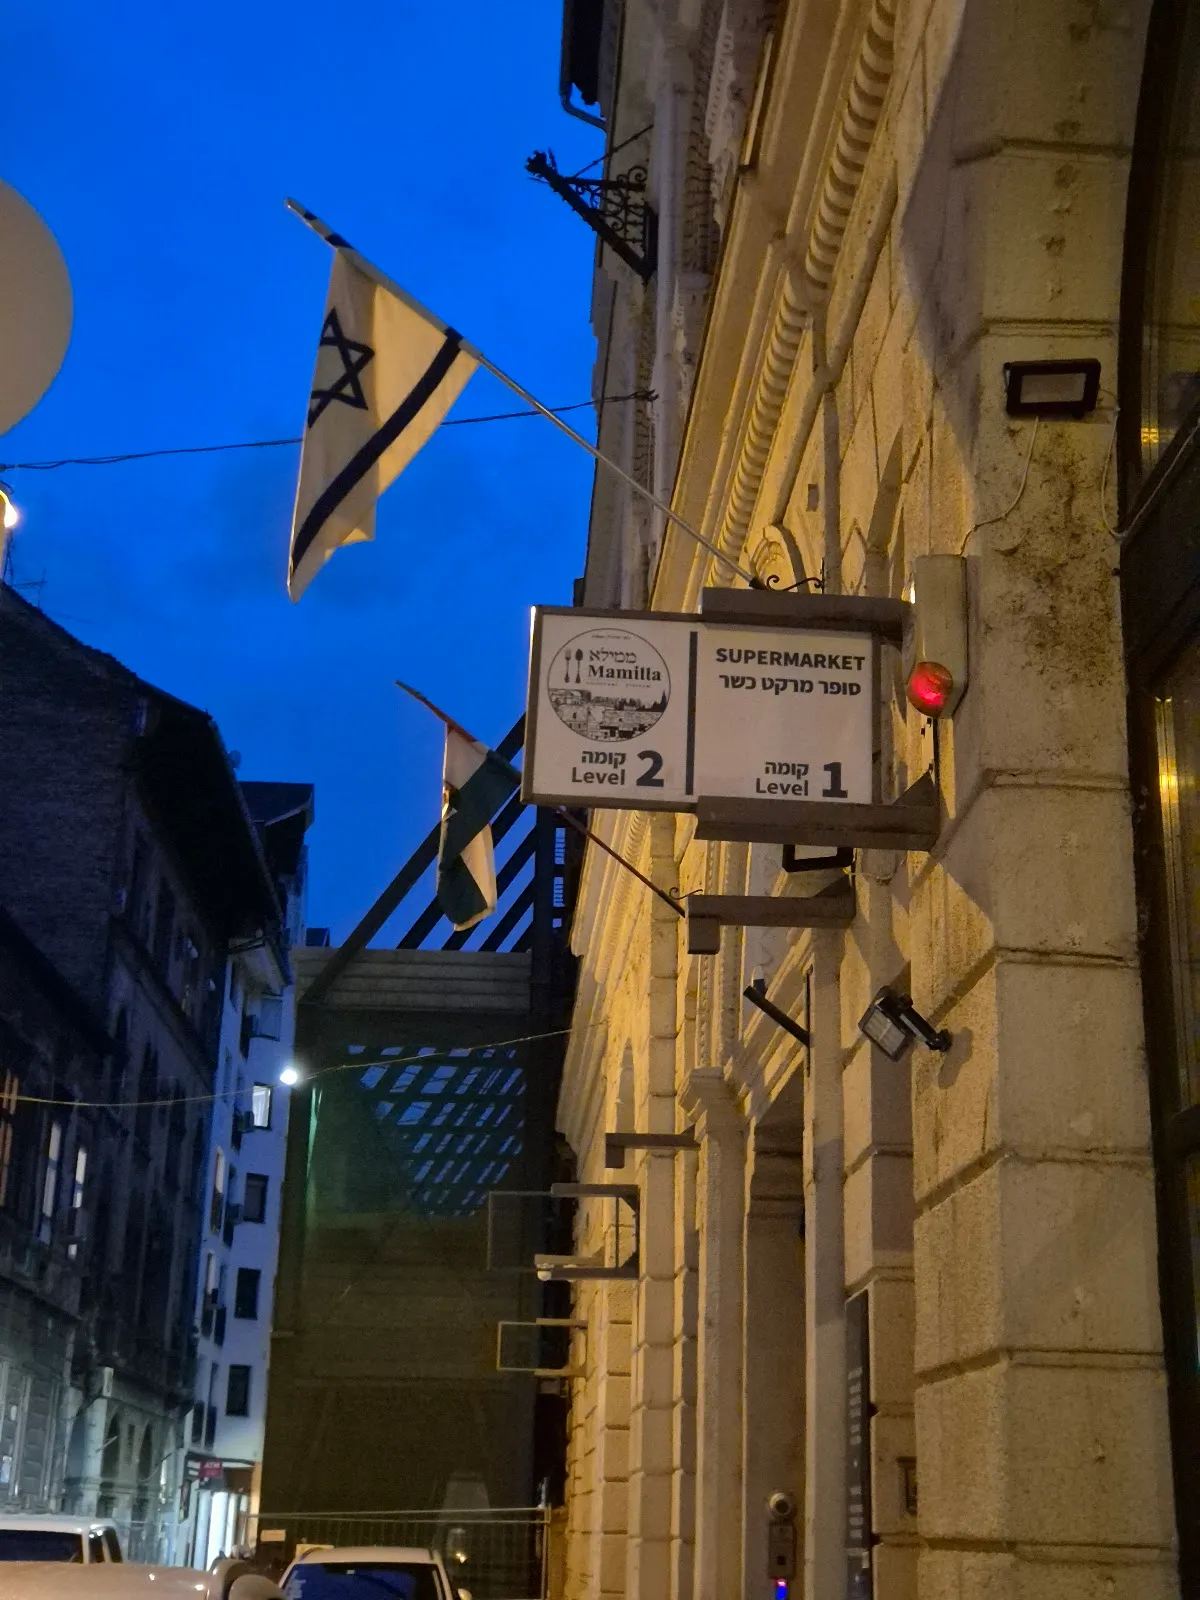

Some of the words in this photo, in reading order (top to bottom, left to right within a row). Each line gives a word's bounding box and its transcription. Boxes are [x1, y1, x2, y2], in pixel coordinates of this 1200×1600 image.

[589, 647, 637, 664] ממילא
[716, 648, 865, 670] SUPERMARKET
[588, 665, 661, 681] Mamilla
[719, 674, 756, 691] כשר
[761, 677, 813, 695] מרקט
[818, 681, 861, 696] סופר
[581, 750, 626, 768] קומה
[571, 767, 625, 786] Level
[636, 750, 664, 787] 2
[764, 761, 809, 779] קומה
[755, 778, 809, 797] Level
[823, 761, 848, 798] 1
